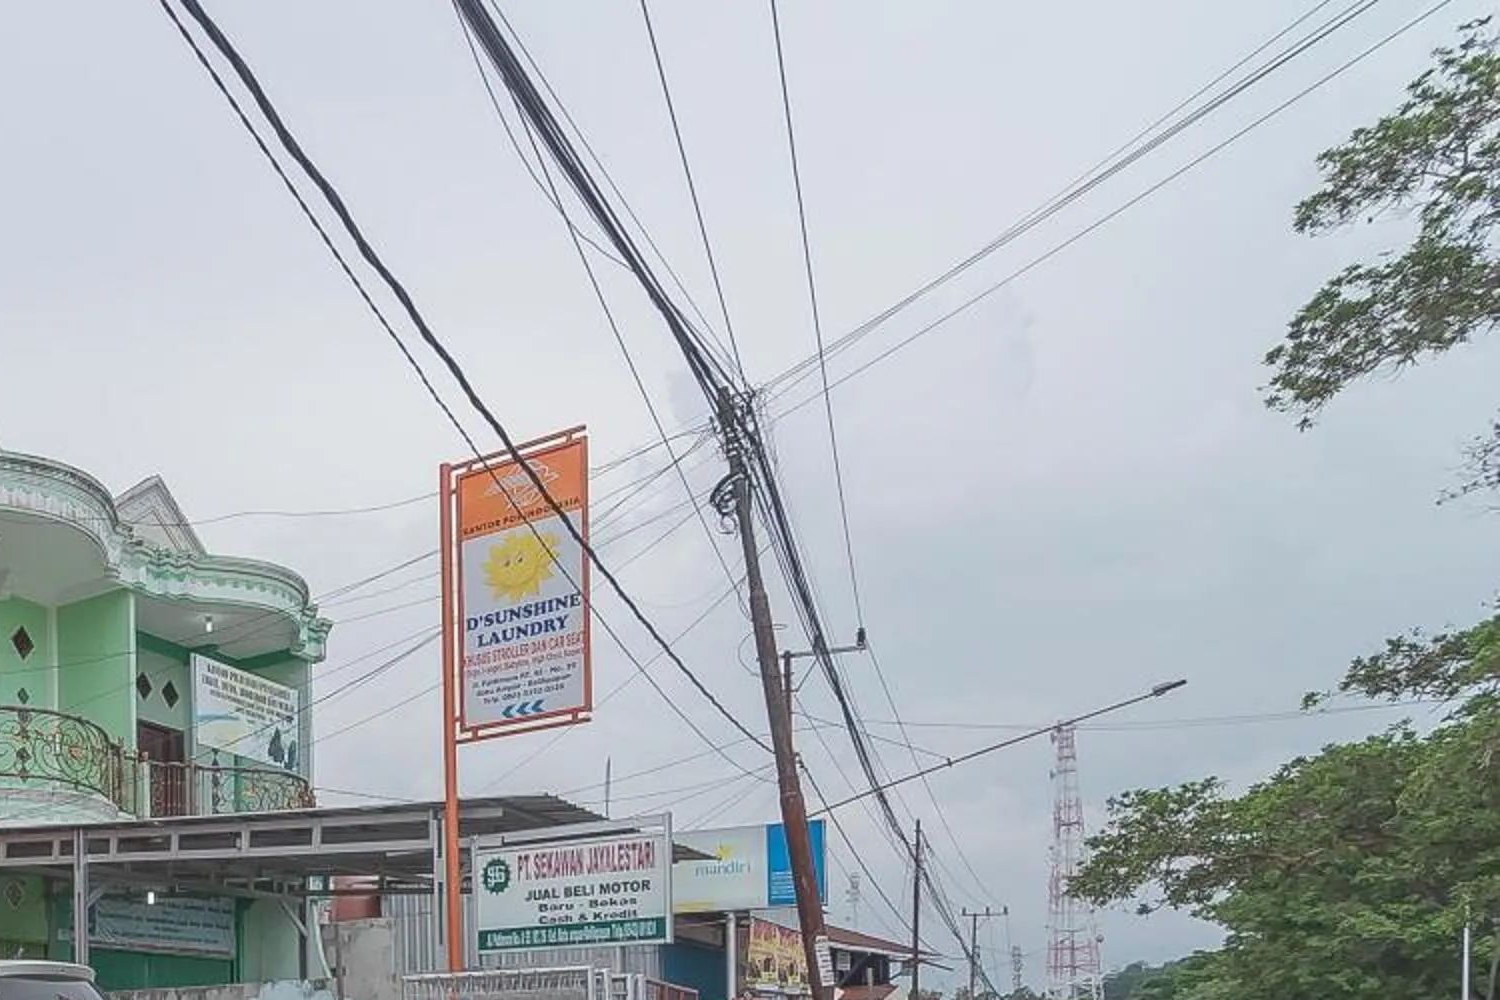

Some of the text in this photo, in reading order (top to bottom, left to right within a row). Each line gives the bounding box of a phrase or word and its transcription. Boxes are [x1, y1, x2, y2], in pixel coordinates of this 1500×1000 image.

[466, 593, 581, 631] D'SUNSHINE
[477, 615, 569, 647] LAUNDRY
[517, 855, 530, 881] PT.
[533, 848, 583, 879] SEKAWAN
[695, 859, 751, 878] mandiri
[525, 879, 651, 901] JUAL BELI MOTOR
[538, 903, 574, 912] Baru
[538, 909, 637, 924] Cash & Kredit
